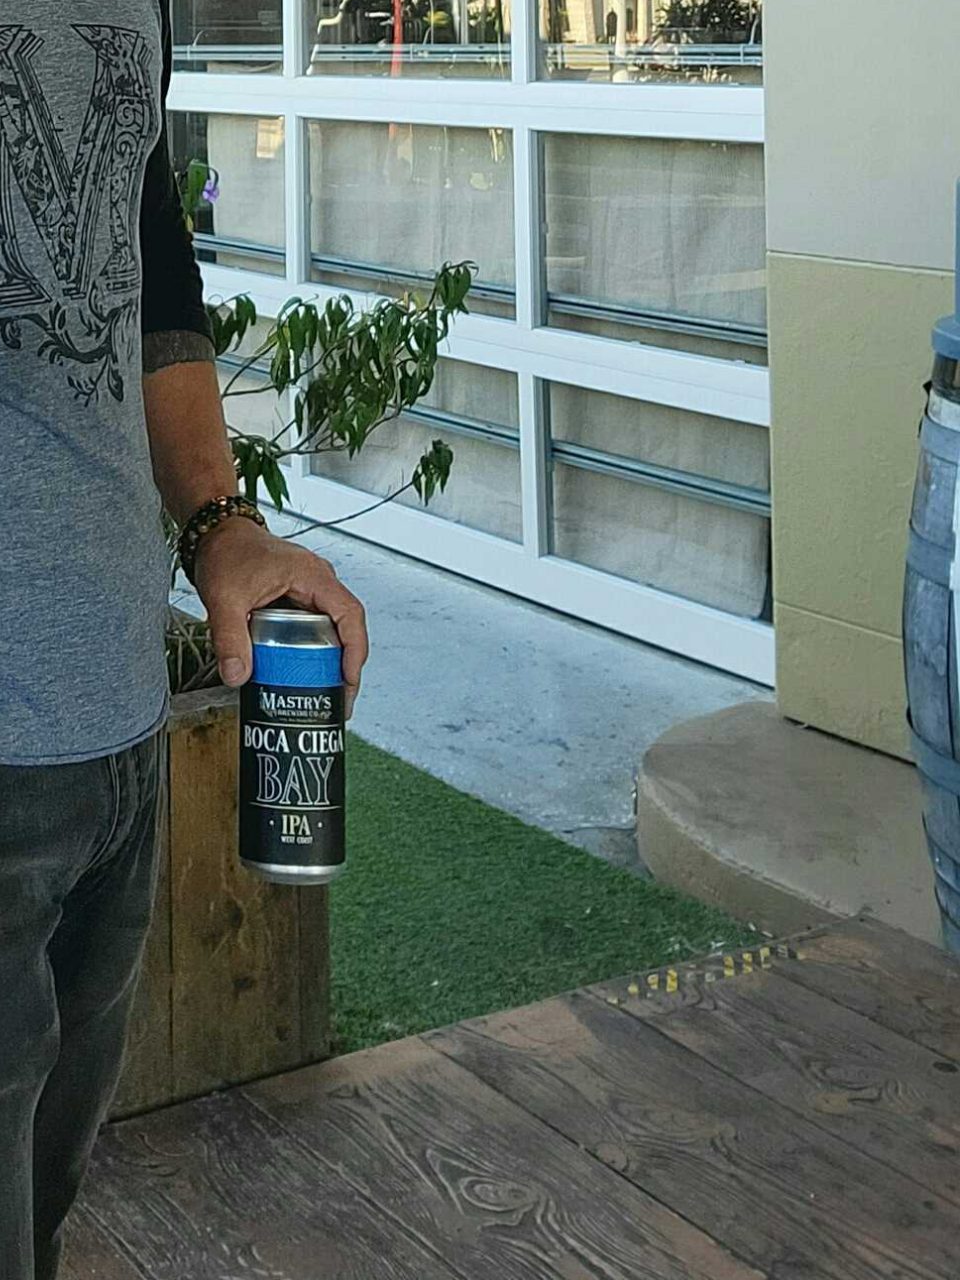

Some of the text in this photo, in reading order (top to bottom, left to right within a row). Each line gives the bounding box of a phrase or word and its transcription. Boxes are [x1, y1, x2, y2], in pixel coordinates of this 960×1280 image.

[243, 725, 290, 754] BOCA
[256, 753, 334, 805] BAY
[282, 814, 311, 836] IPA
